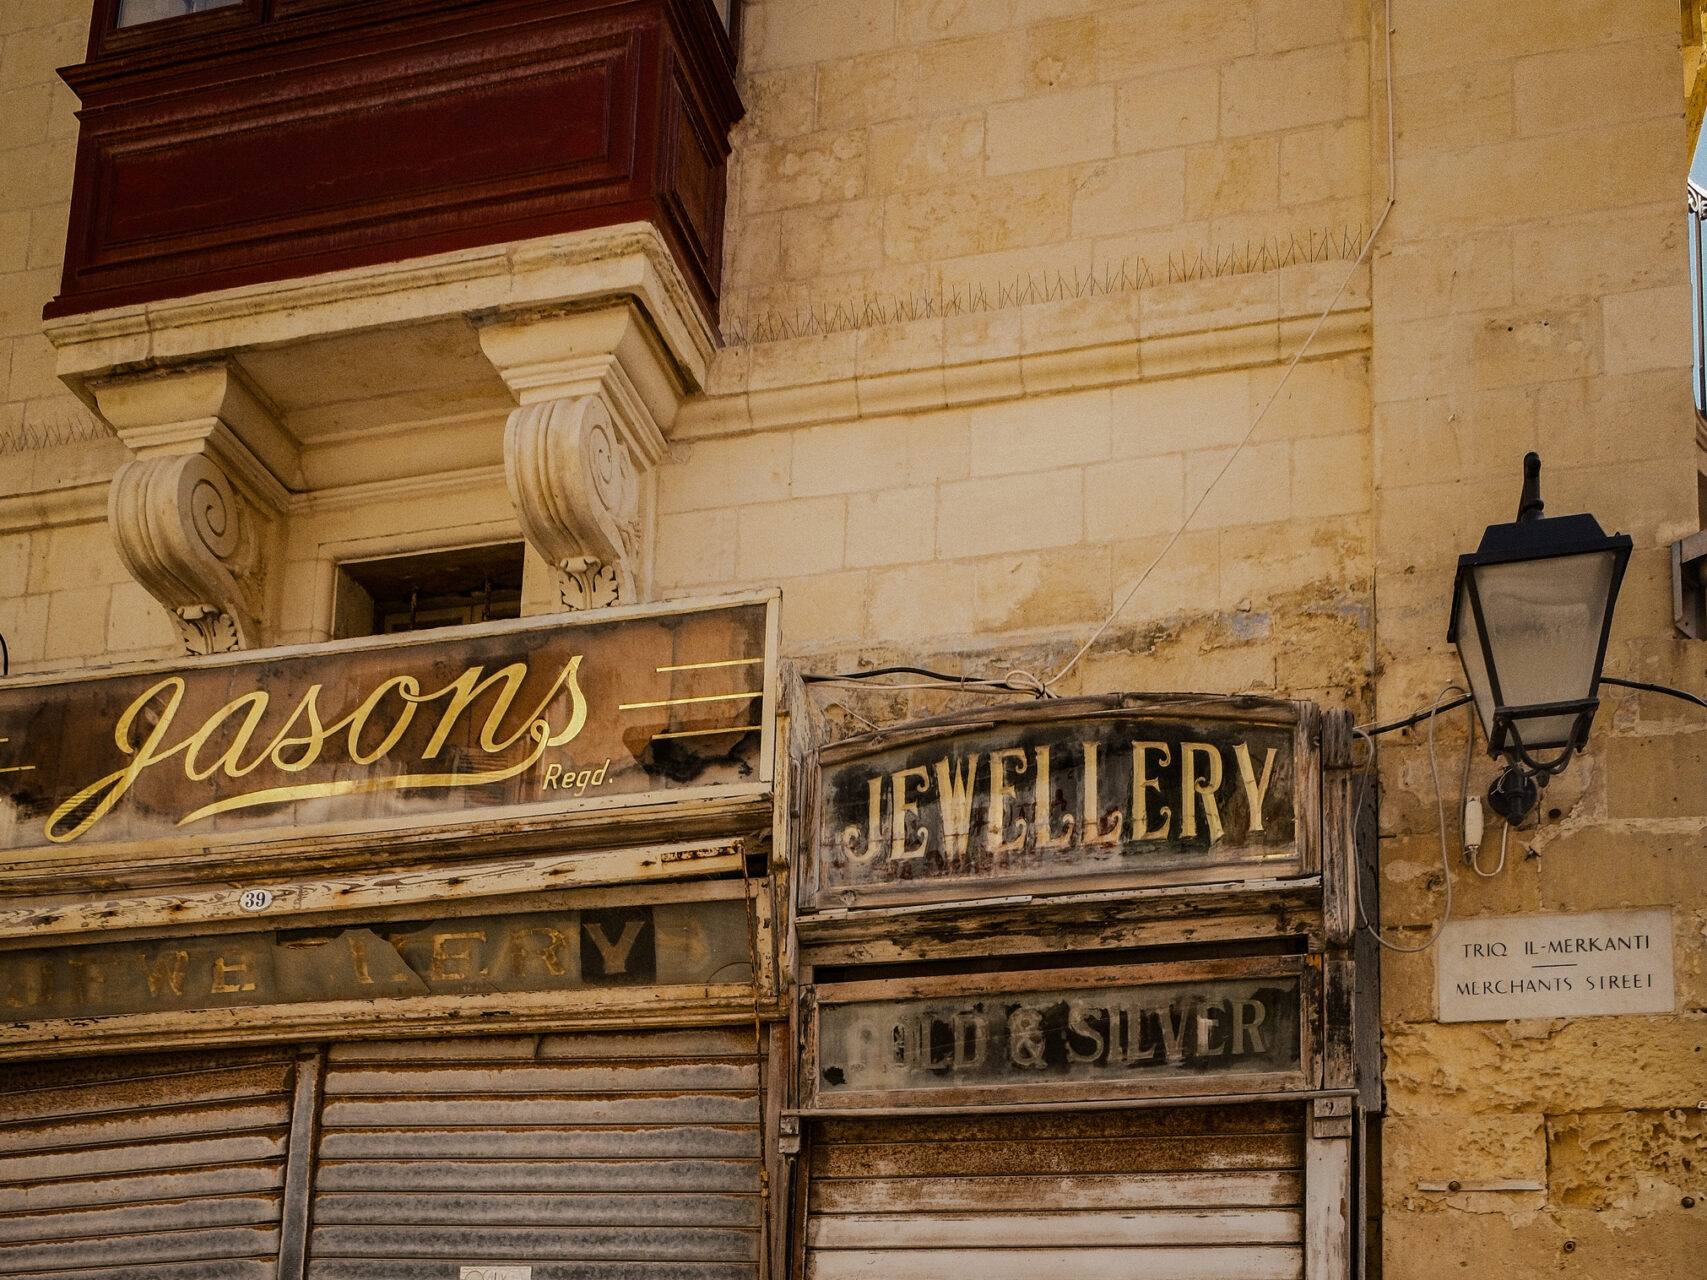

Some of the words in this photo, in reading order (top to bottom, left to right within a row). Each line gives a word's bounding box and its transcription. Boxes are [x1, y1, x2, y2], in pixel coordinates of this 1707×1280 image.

[44, 655, 588, 843] Jasons
[542, 757, 614, 797] Regd.
[843, 740, 1278, 862] JEWELLERY
[245, 892, 266, 908] 39
[1463, 942, 1508, 959] TRIQ
[1525, 934, 1650, 956] IL-MERKANTI
[1456, 976, 1573, 996] MERCHANTS
[1586, 973, 1655, 990] STREET
[846, 1011, 989, 1070] OLD
[1008, 1007, 1049, 1069] &
[1065, 998, 1267, 1064] SILVER
